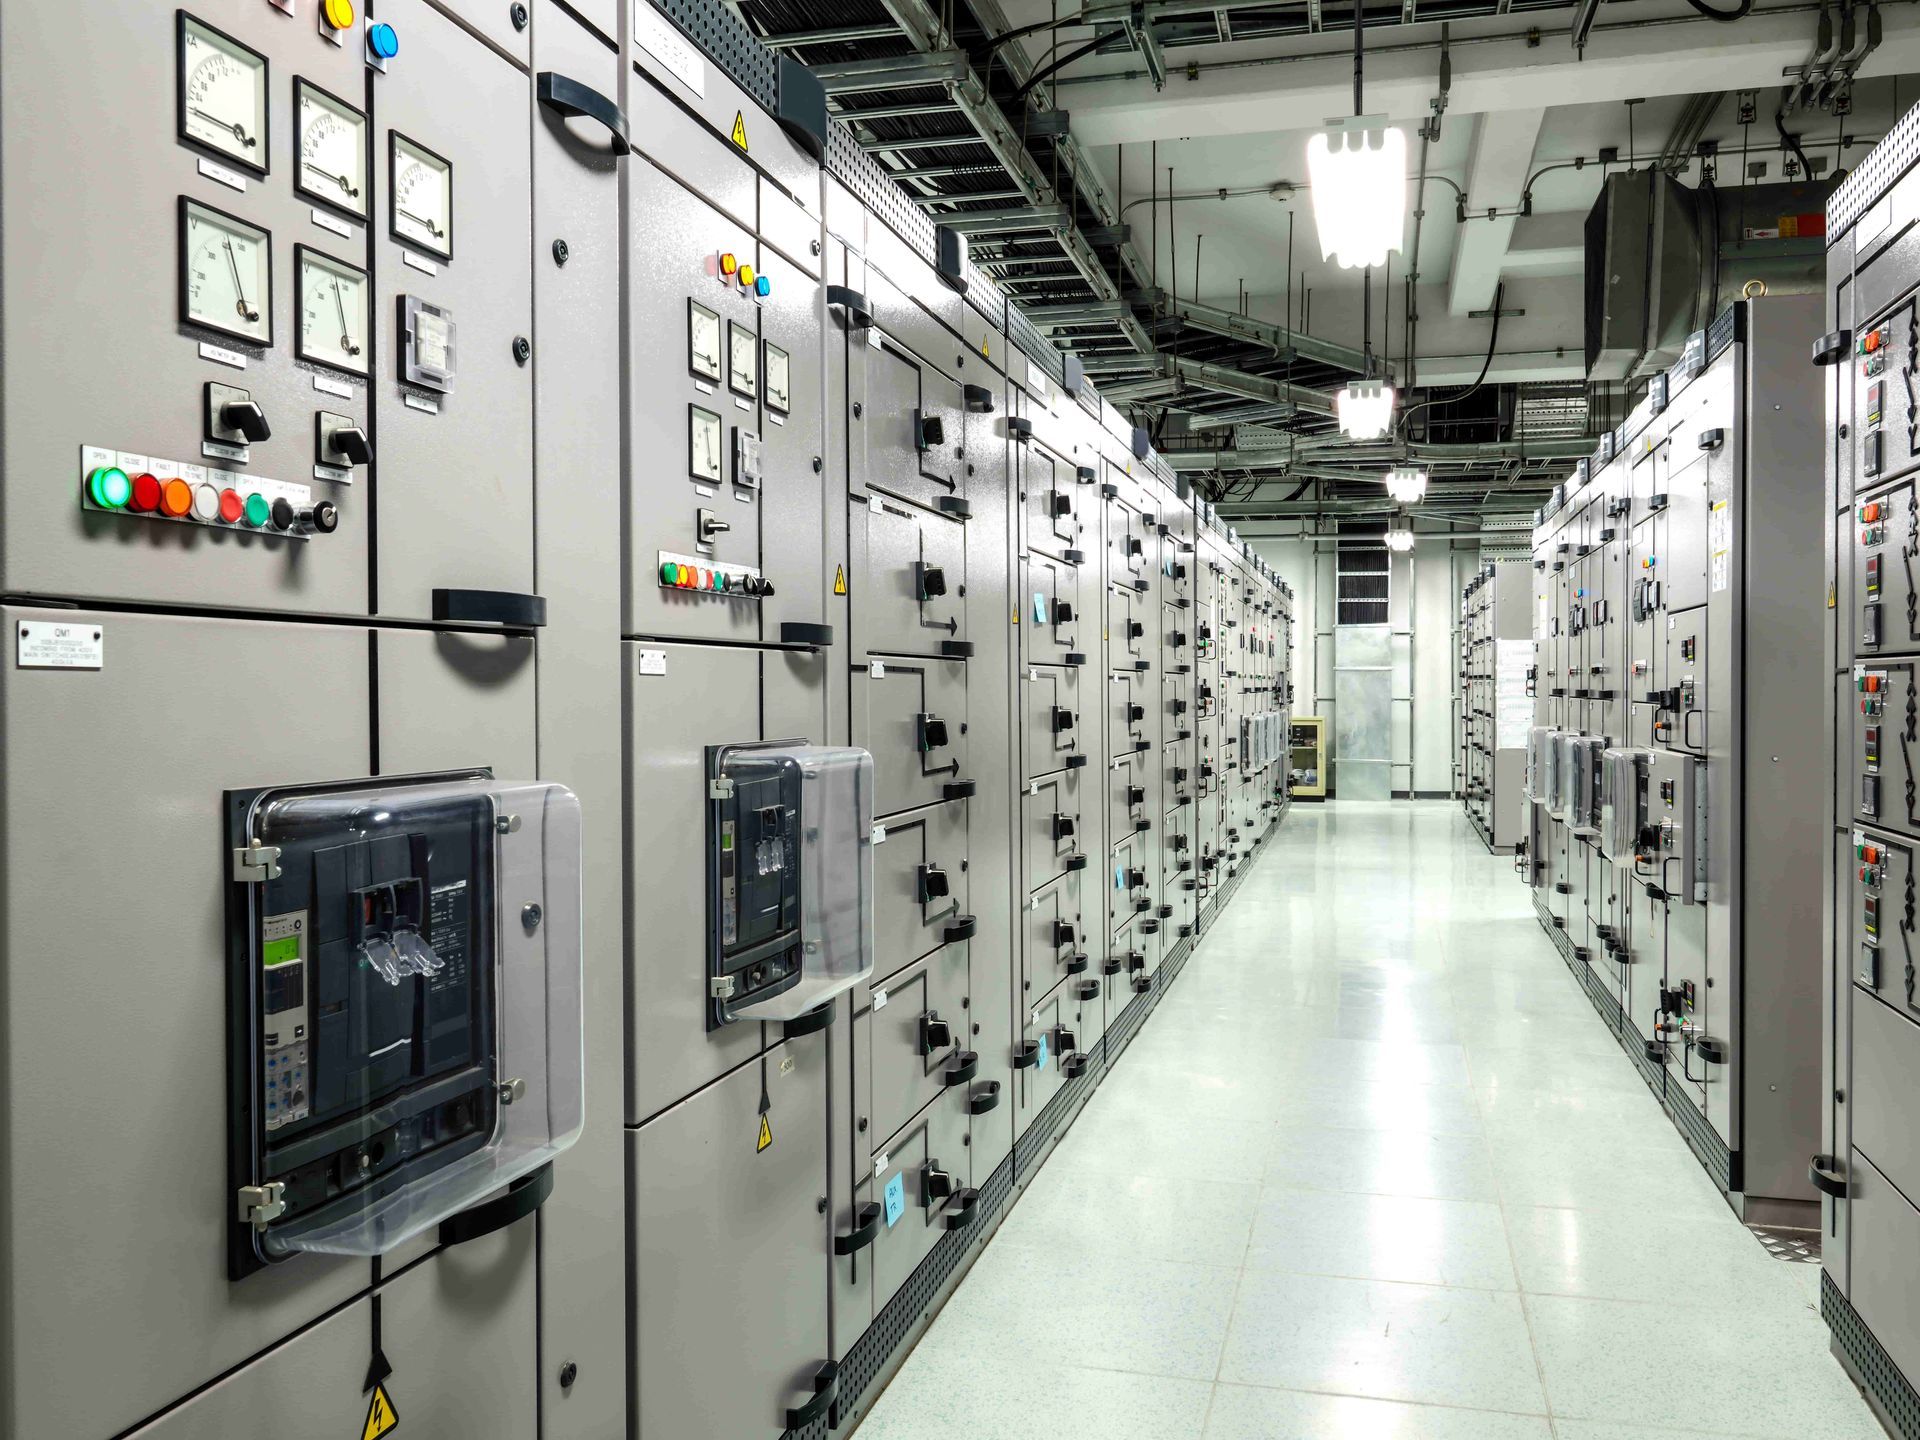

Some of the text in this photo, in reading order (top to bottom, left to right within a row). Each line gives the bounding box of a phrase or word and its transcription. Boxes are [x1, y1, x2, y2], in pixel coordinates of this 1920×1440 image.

[190, 217, 198, 230] V
[208, 251, 216, 260] 300
[304, 263, 310, 274] V
[93, 451, 107, 460] OPEN
[124, 457, 140, 466] CLOSE
[156, 462, 171, 471] FAULT
[214, 472, 228, 481] CLOSE
[54, 628, 70, 637] QM1
